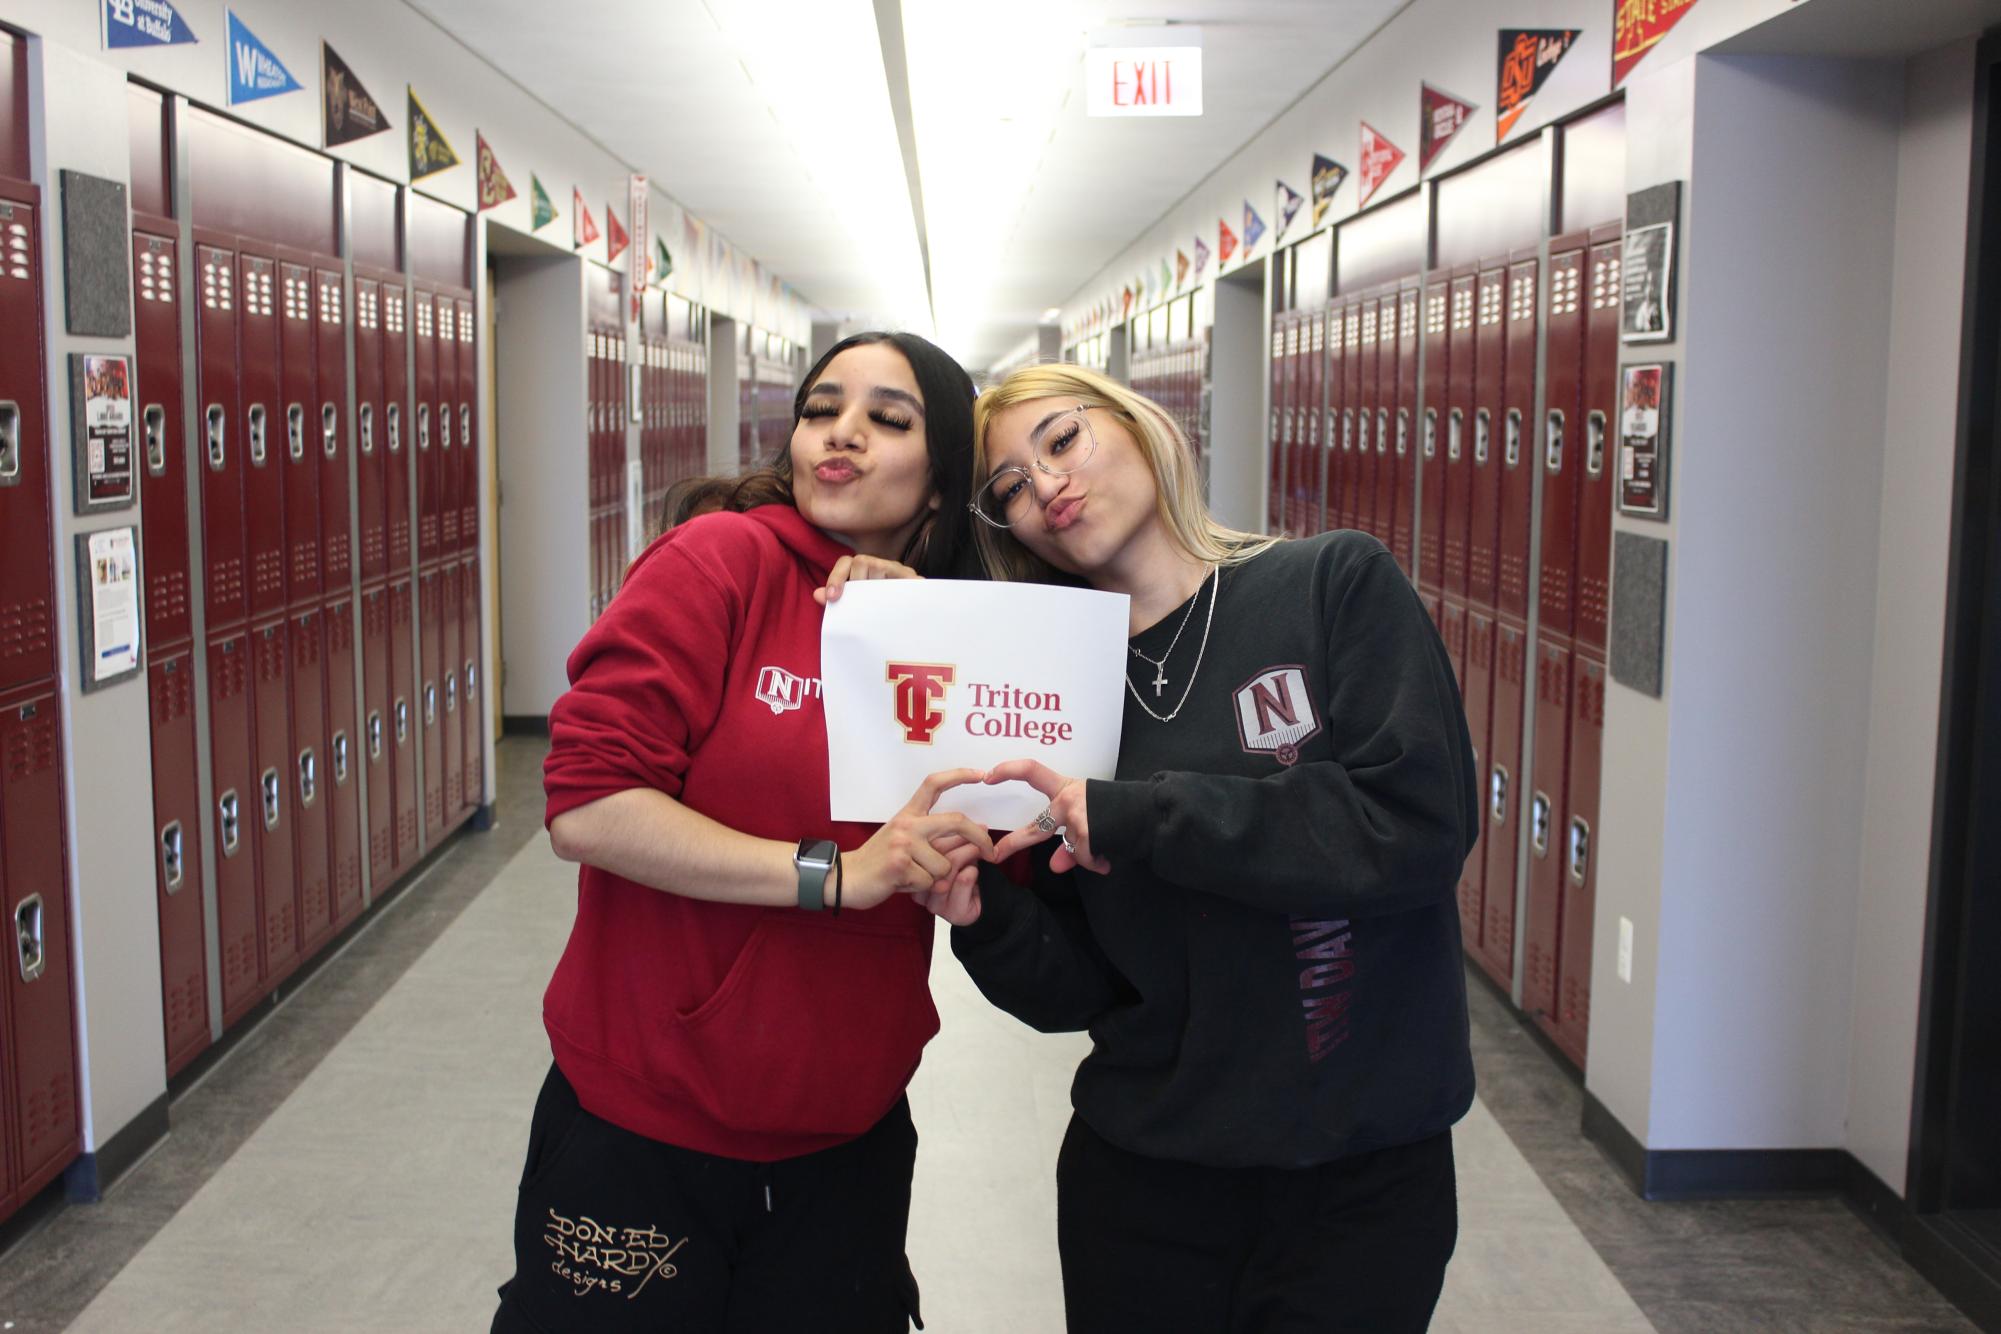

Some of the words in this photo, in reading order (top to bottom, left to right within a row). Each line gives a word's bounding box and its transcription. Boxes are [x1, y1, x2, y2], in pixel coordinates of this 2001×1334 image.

[235, 40, 257, 89] W
[1112, 60, 1173, 106] EXIT
[768, 669, 795, 701] N
[967, 683, 1062, 712] Triton
[1248, 672, 1301, 736] N
[964, 711, 1073, 746] College
[546, 1207, 617, 1245] DON
[544, 1233, 689, 1300] HARDY
[551, 1260, 623, 1297] designs
